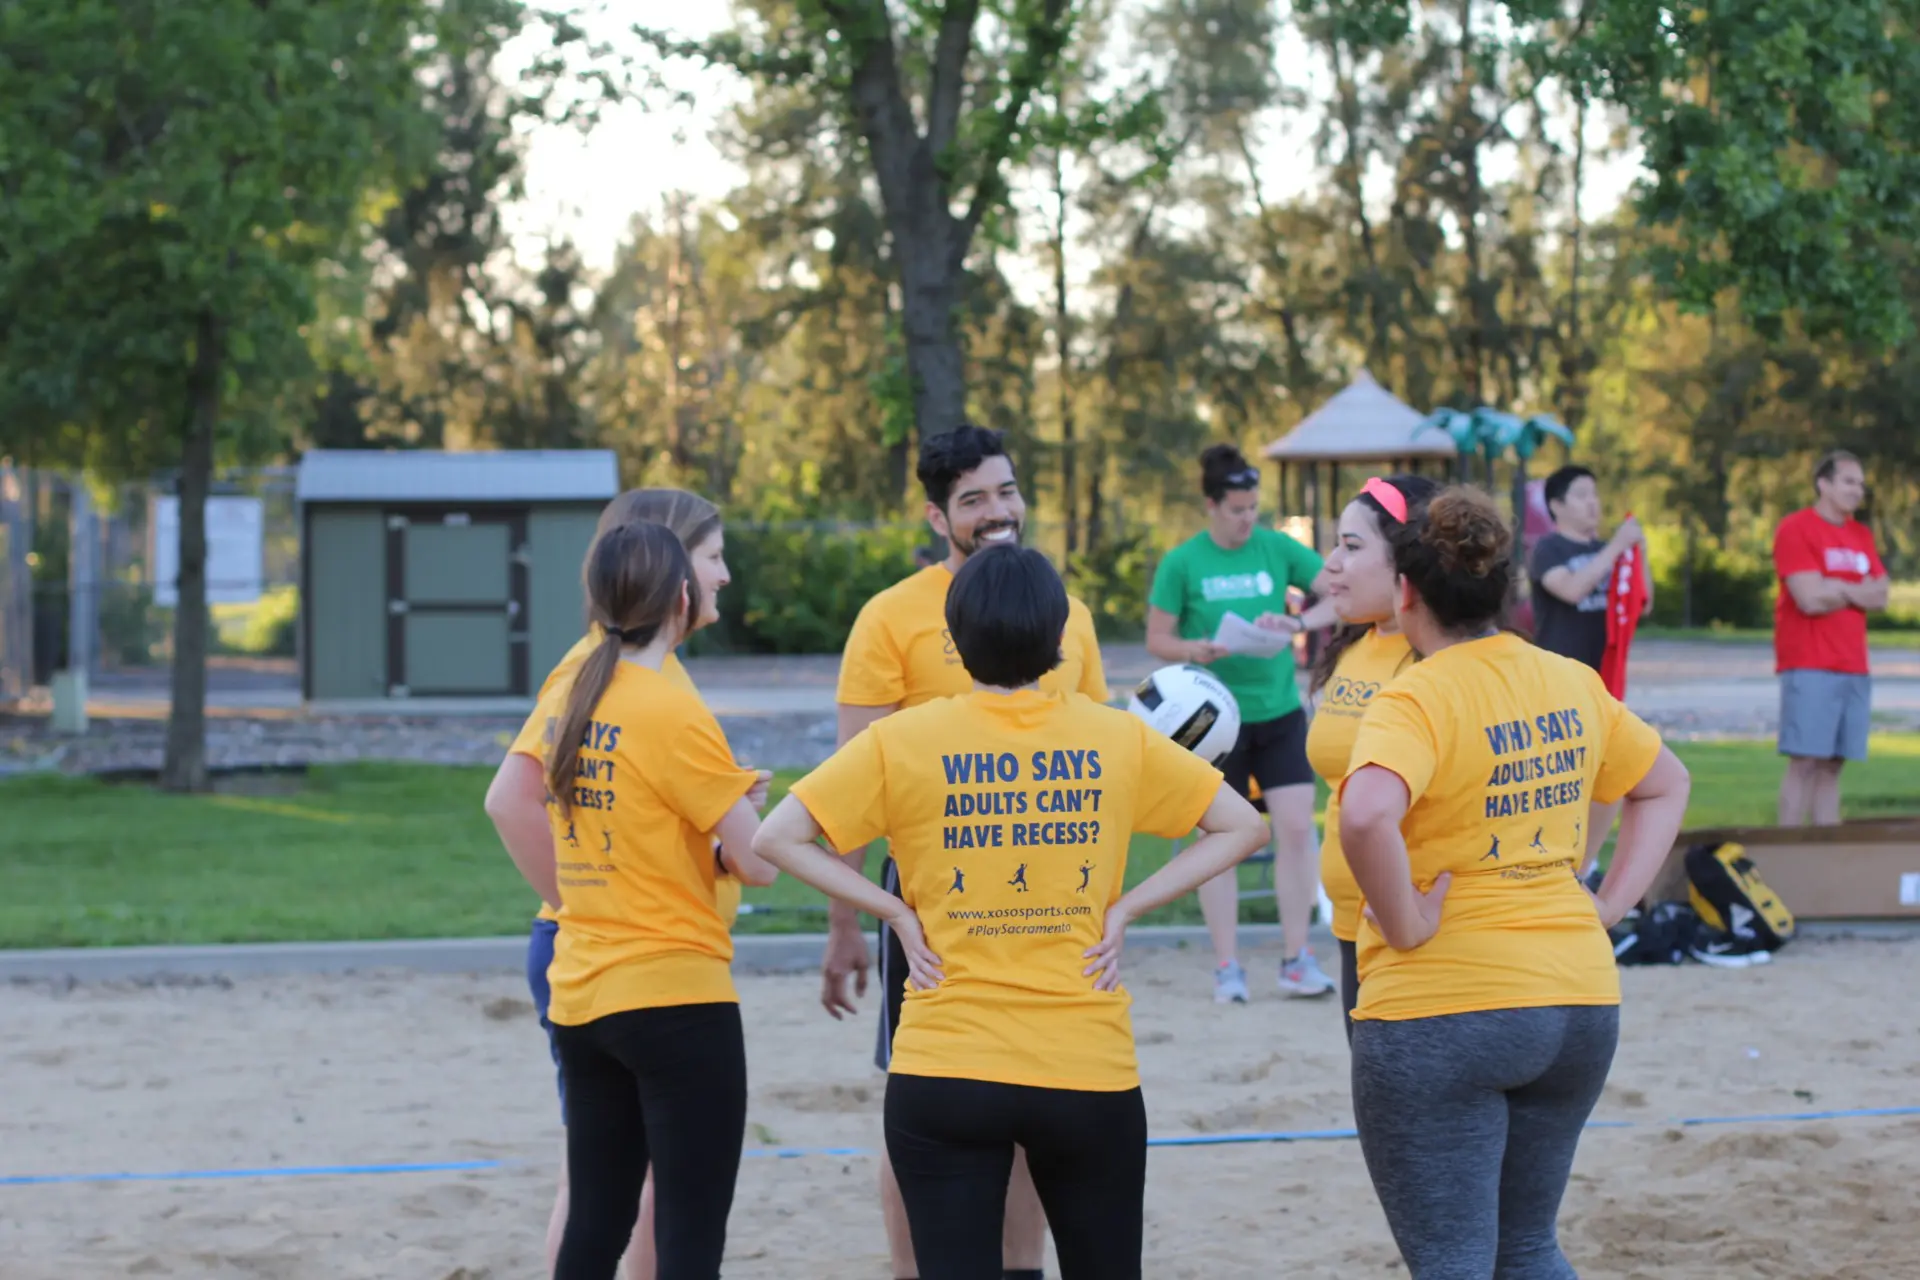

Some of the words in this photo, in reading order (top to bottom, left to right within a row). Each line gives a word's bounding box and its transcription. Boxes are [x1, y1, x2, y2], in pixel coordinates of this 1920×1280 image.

[580, 719, 621, 752] AYS
[1536, 708, 1583, 744] SAYS
[576, 757, 615, 782] AN'T
[942, 753, 1019, 784] WHO
[1031, 750, 1102, 781] SAYS
[1546, 747, 1586, 775] CAN'T
[944, 791, 1028, 817] ADULTS
[1036, 789, 1102, 813] CAN'T
[943, 825, 1003, 849] HAVE
[1012, 820, 1100, 846] RECESS?
[947, 904, 1091, 920] www.xososports.com
[967, 923, 1071, 937] #PlaySacramento
